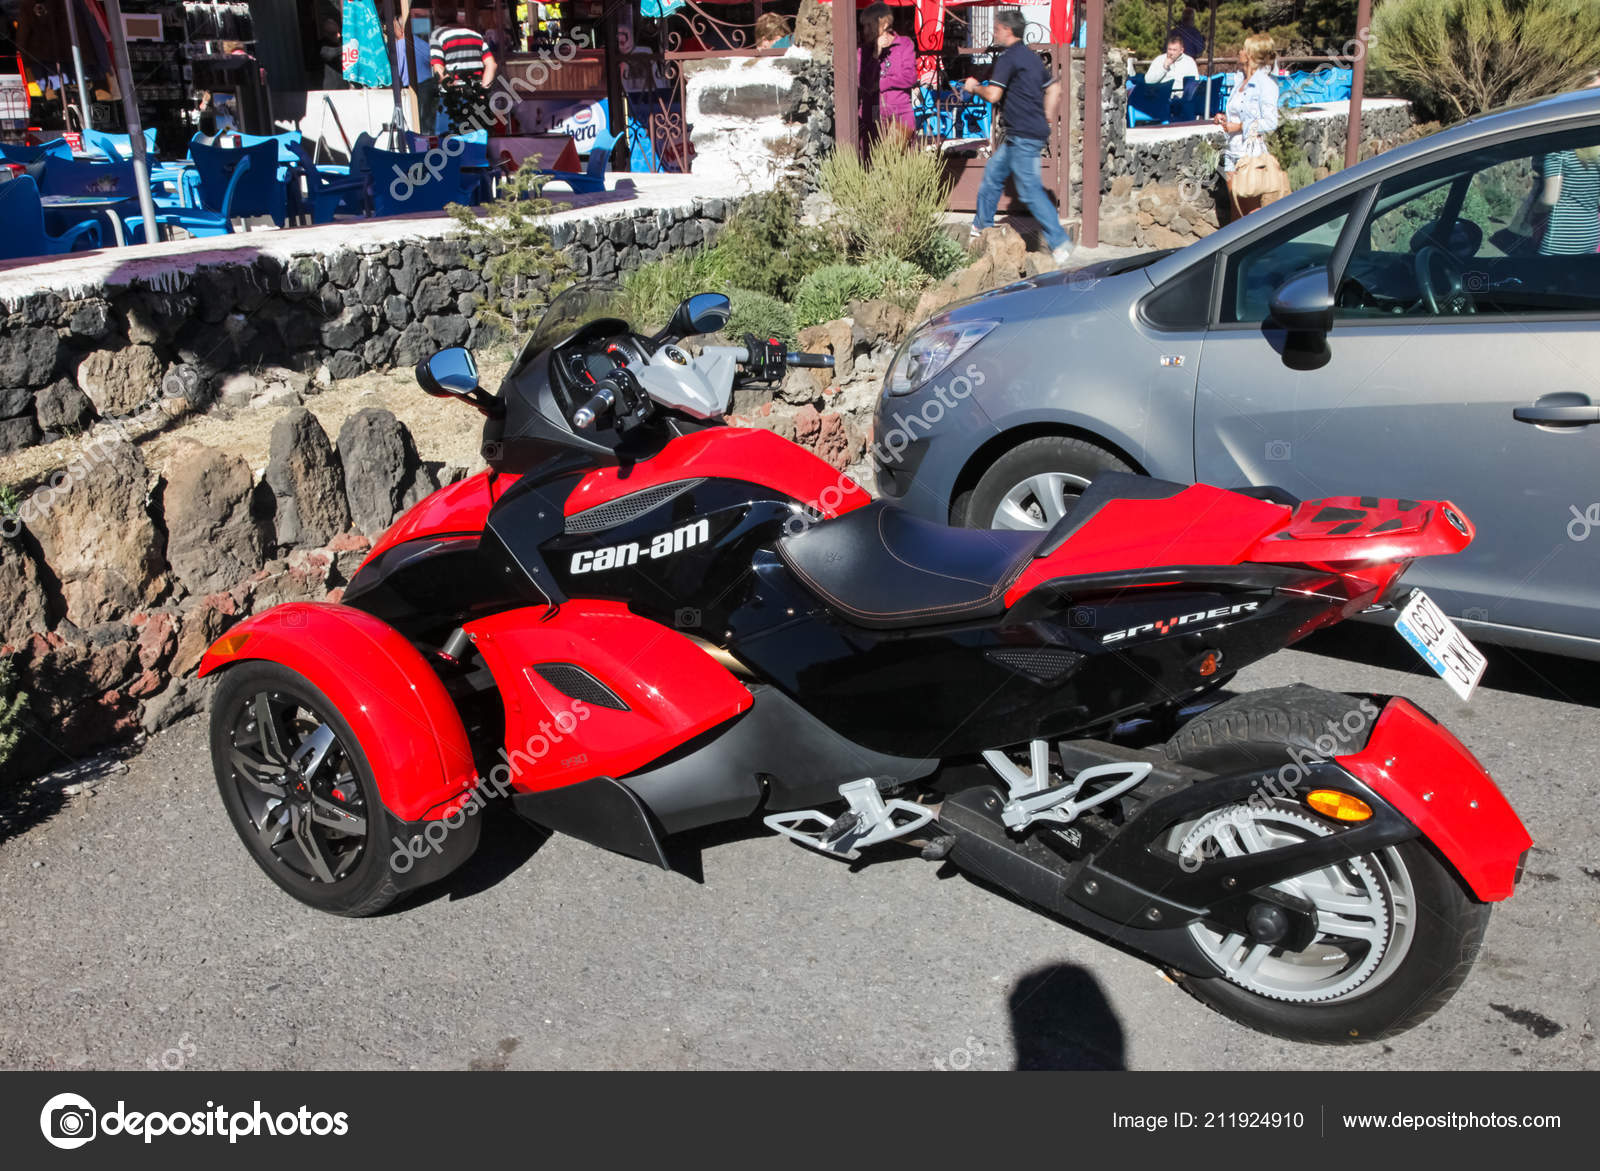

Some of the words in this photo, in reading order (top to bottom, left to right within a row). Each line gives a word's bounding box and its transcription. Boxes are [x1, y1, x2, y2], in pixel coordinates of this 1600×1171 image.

[570, 519, 709, 575] can-am
[1102, 602, 1259, 644] SPYDER
[1407, 597, 1447, 648] 4627
[1442, 632, 1482, 685] GWK
